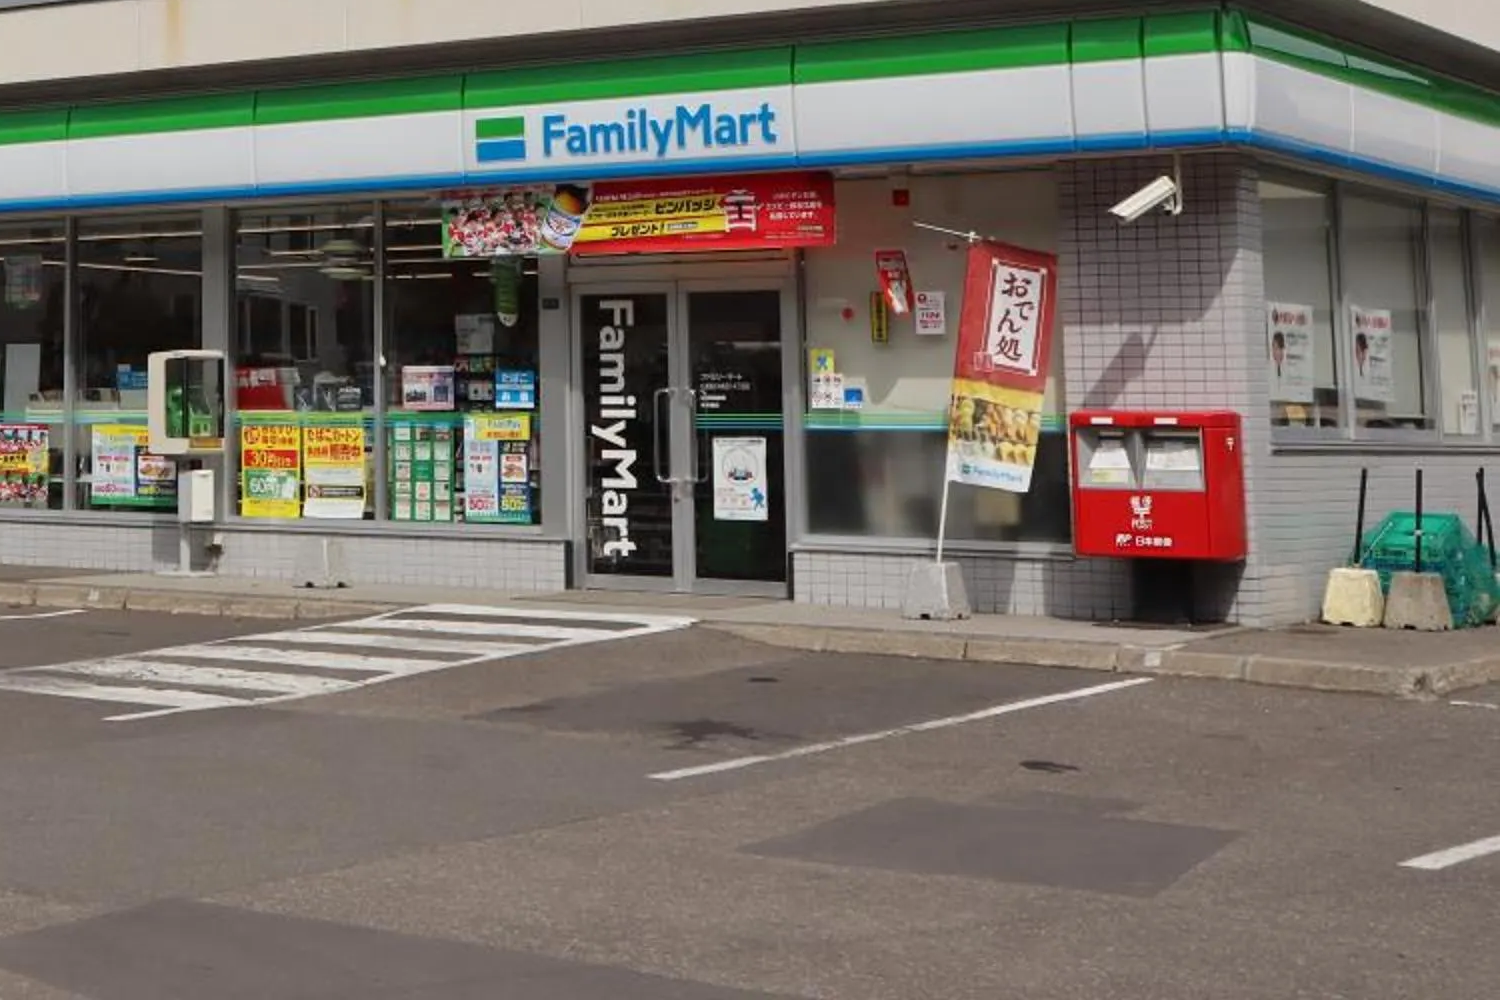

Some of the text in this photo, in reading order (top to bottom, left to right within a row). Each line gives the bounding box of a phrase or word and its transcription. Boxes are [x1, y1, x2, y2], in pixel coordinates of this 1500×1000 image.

[542, 102, 778, 158] FamilyMart
[996, 271, 1035, 361] おでん処
[591, 299, 638, 557] FamilyMart
